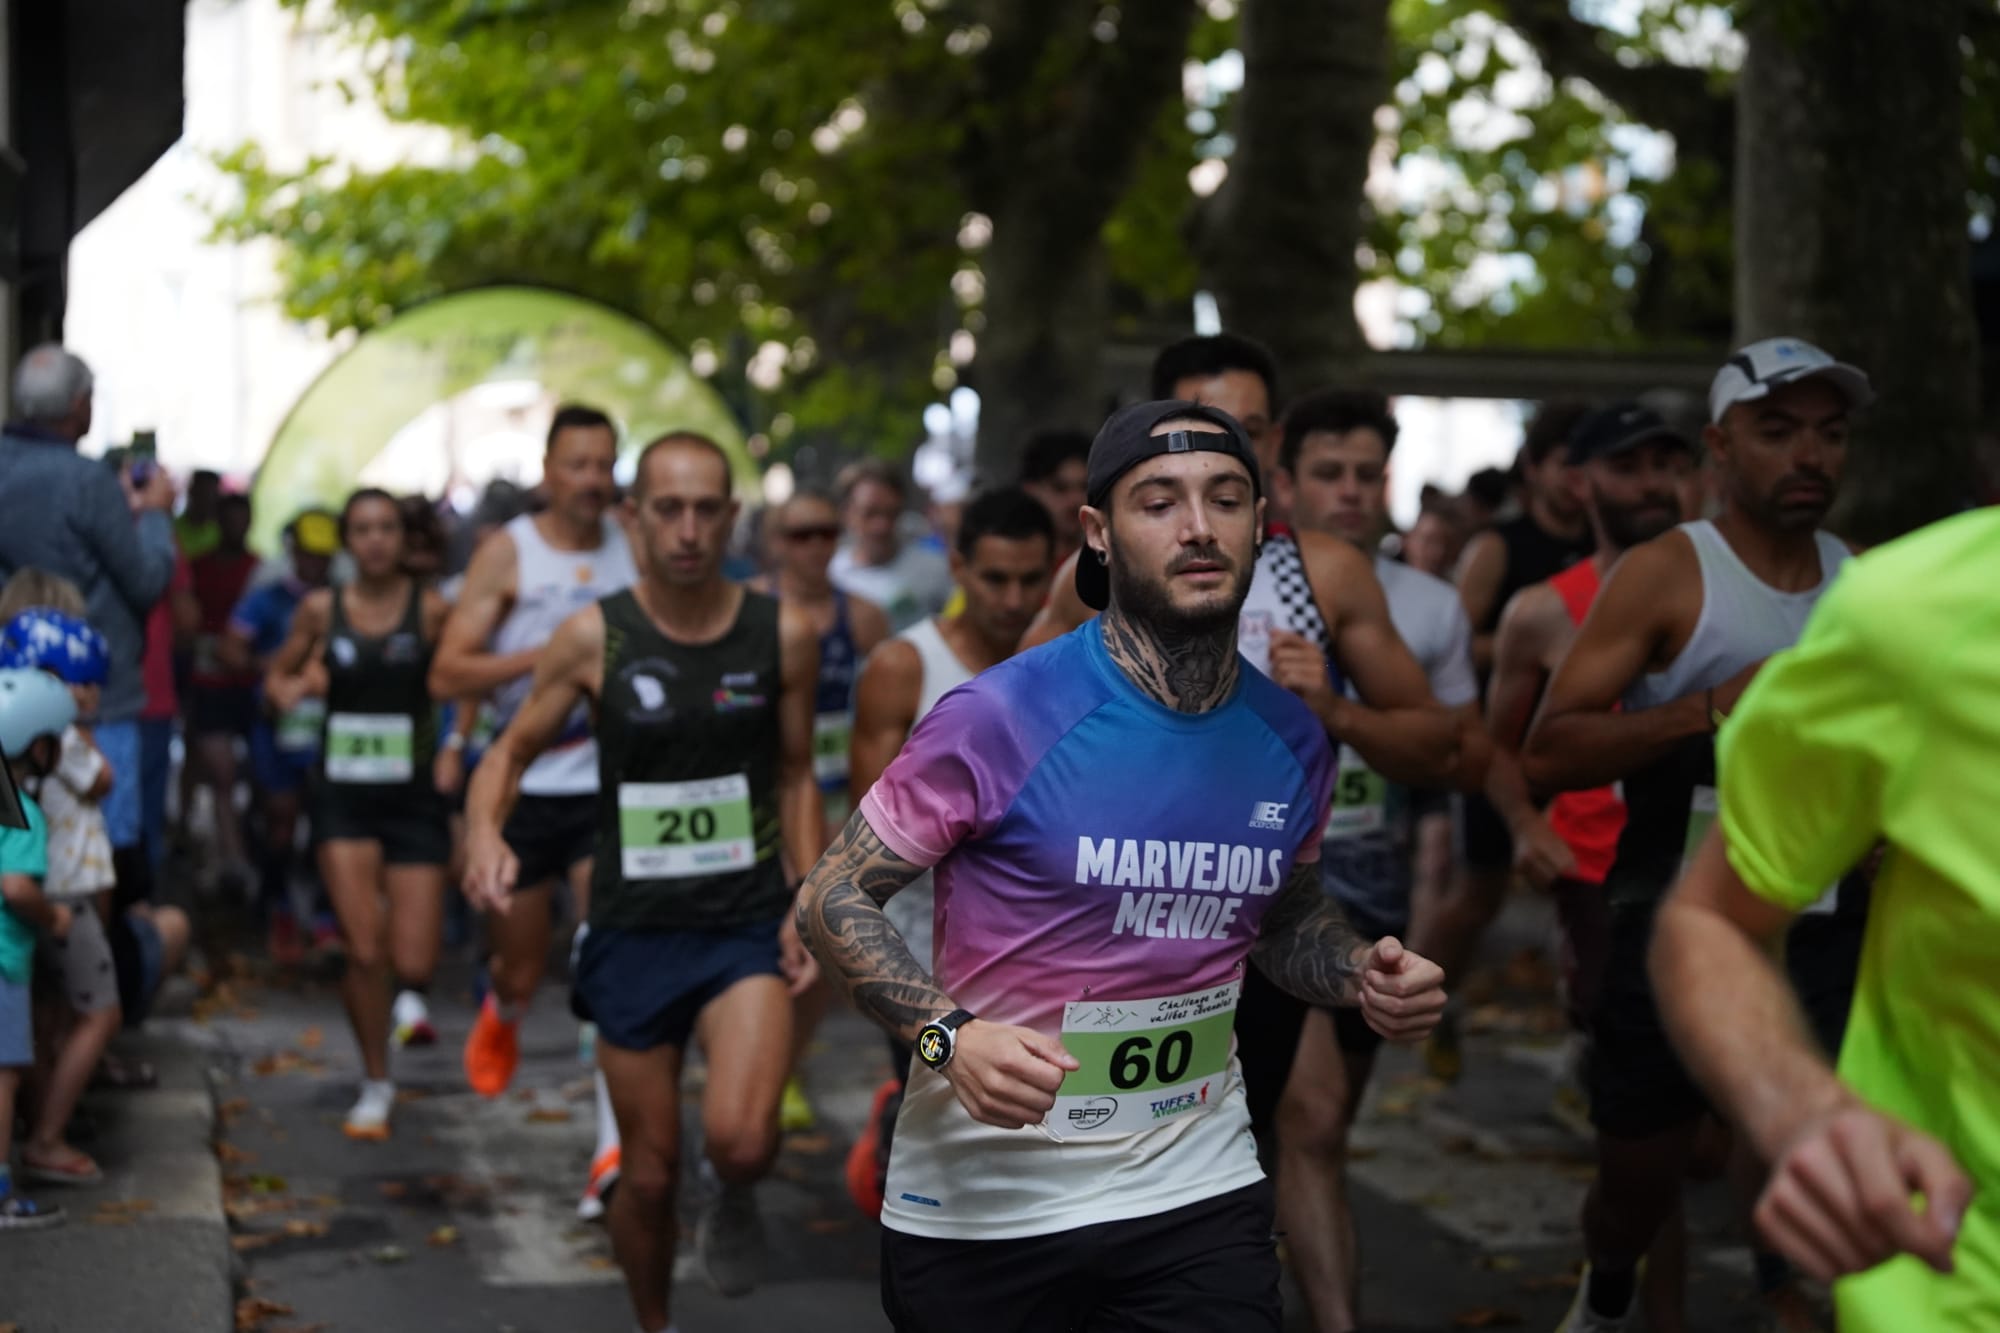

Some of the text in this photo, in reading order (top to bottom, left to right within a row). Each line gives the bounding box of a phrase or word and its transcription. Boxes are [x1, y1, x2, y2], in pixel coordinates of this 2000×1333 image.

[1331, 770, 1368, 806] 5
[656, 807, 717, 844] 20
[1075, 836, 1282, 896] MARVEJOLS
[1112, 891, 1243, 940] MENDE
[1158, 994, 1210, 1011] Challenge
[1109, 1030, 1193, 1090] 60
[1068, 1108, 1110, 1120] BFP
[1150, 1092, 1196, 1113] TUFF'S
